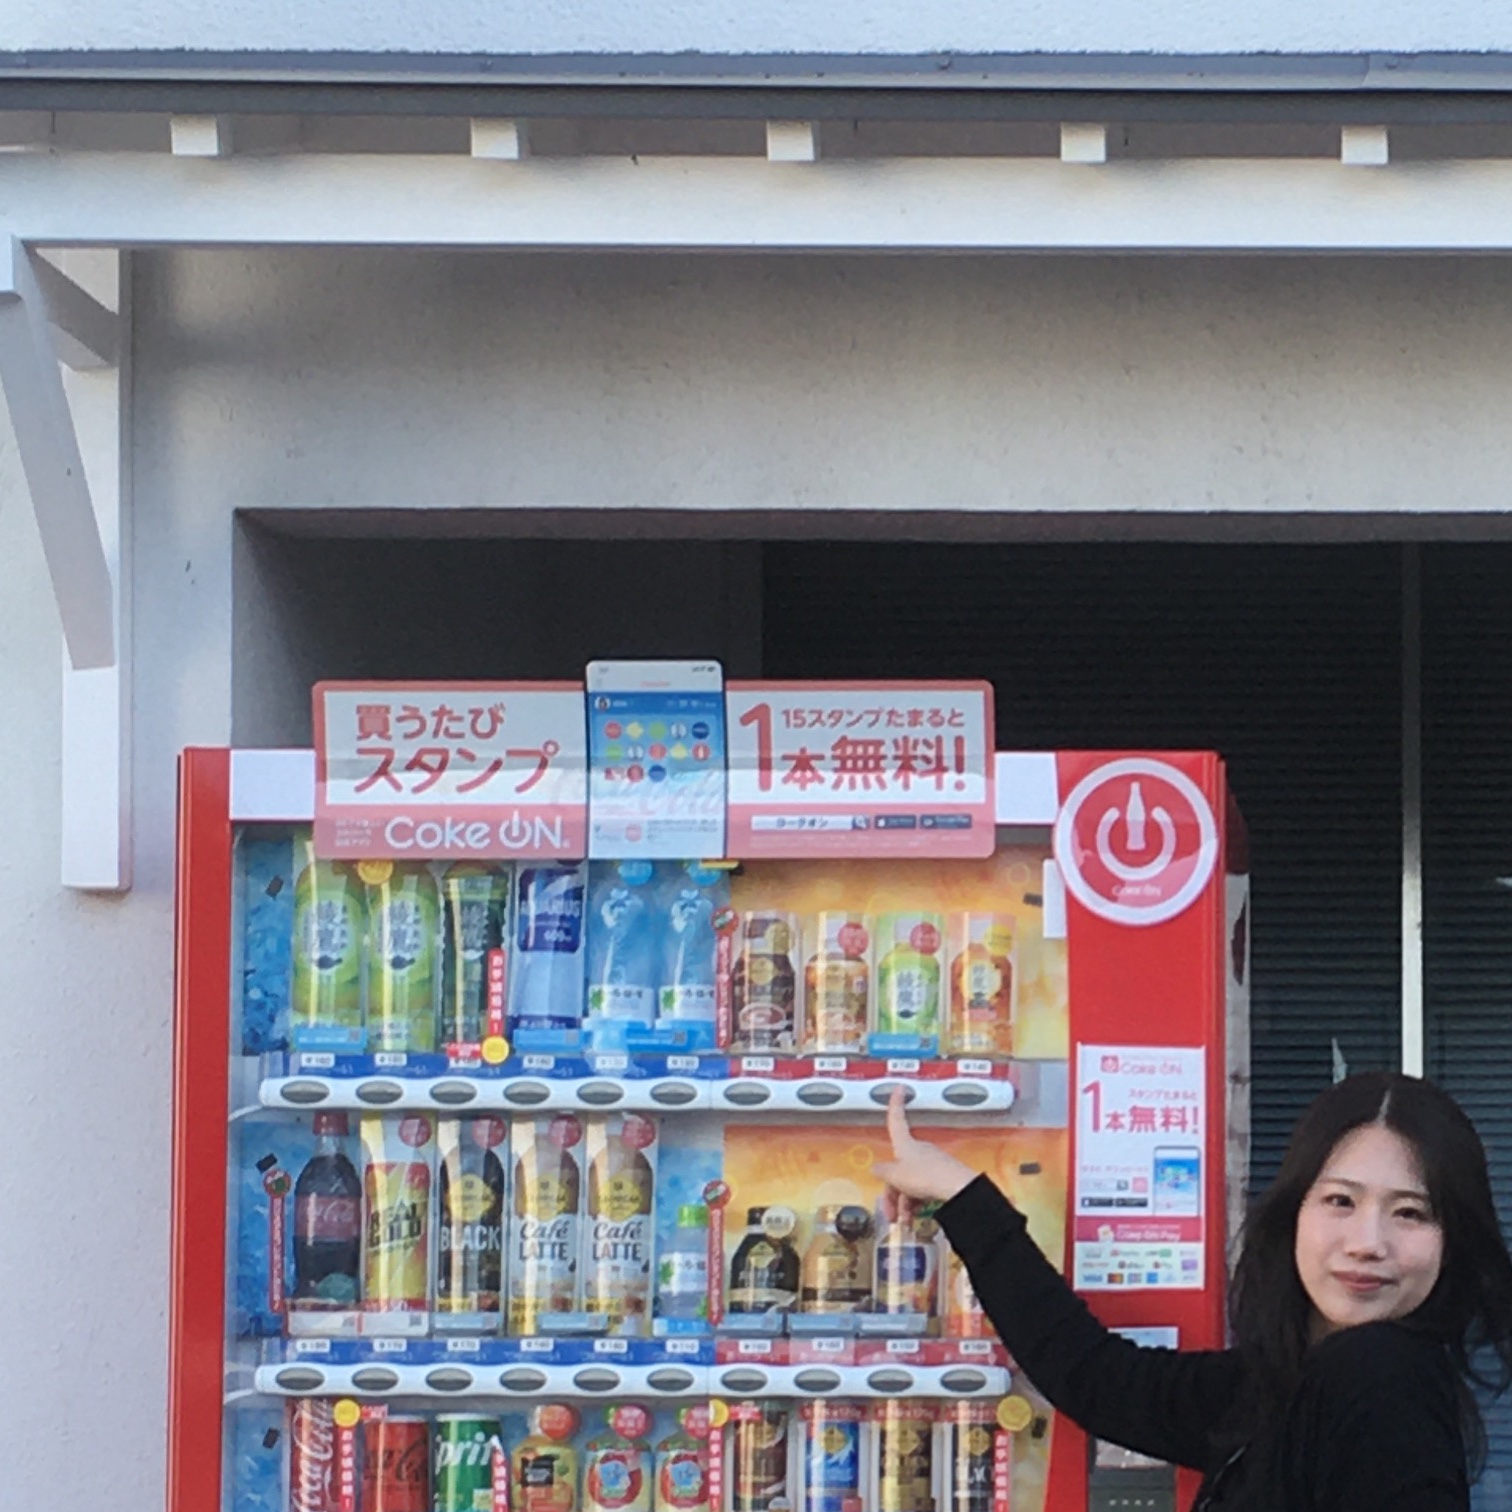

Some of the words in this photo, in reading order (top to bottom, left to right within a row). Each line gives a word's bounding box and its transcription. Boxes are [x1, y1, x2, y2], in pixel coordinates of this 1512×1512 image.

[356, 704, 505, 740] 買うたび
[782, 708, 965, 730] 15スタンプたまると
[354, 740, 560, 794] スタンプ
[385, 815, 491, 849] Coke
[440, 1225, 501, 1251] BLACK
[519, 1220, 571, 1240] Café
[593, 1220, 643, 1241] Café
[519, 1241, 569, 1261] LATTE
[592, 1241, 643, 1261] LATTE
